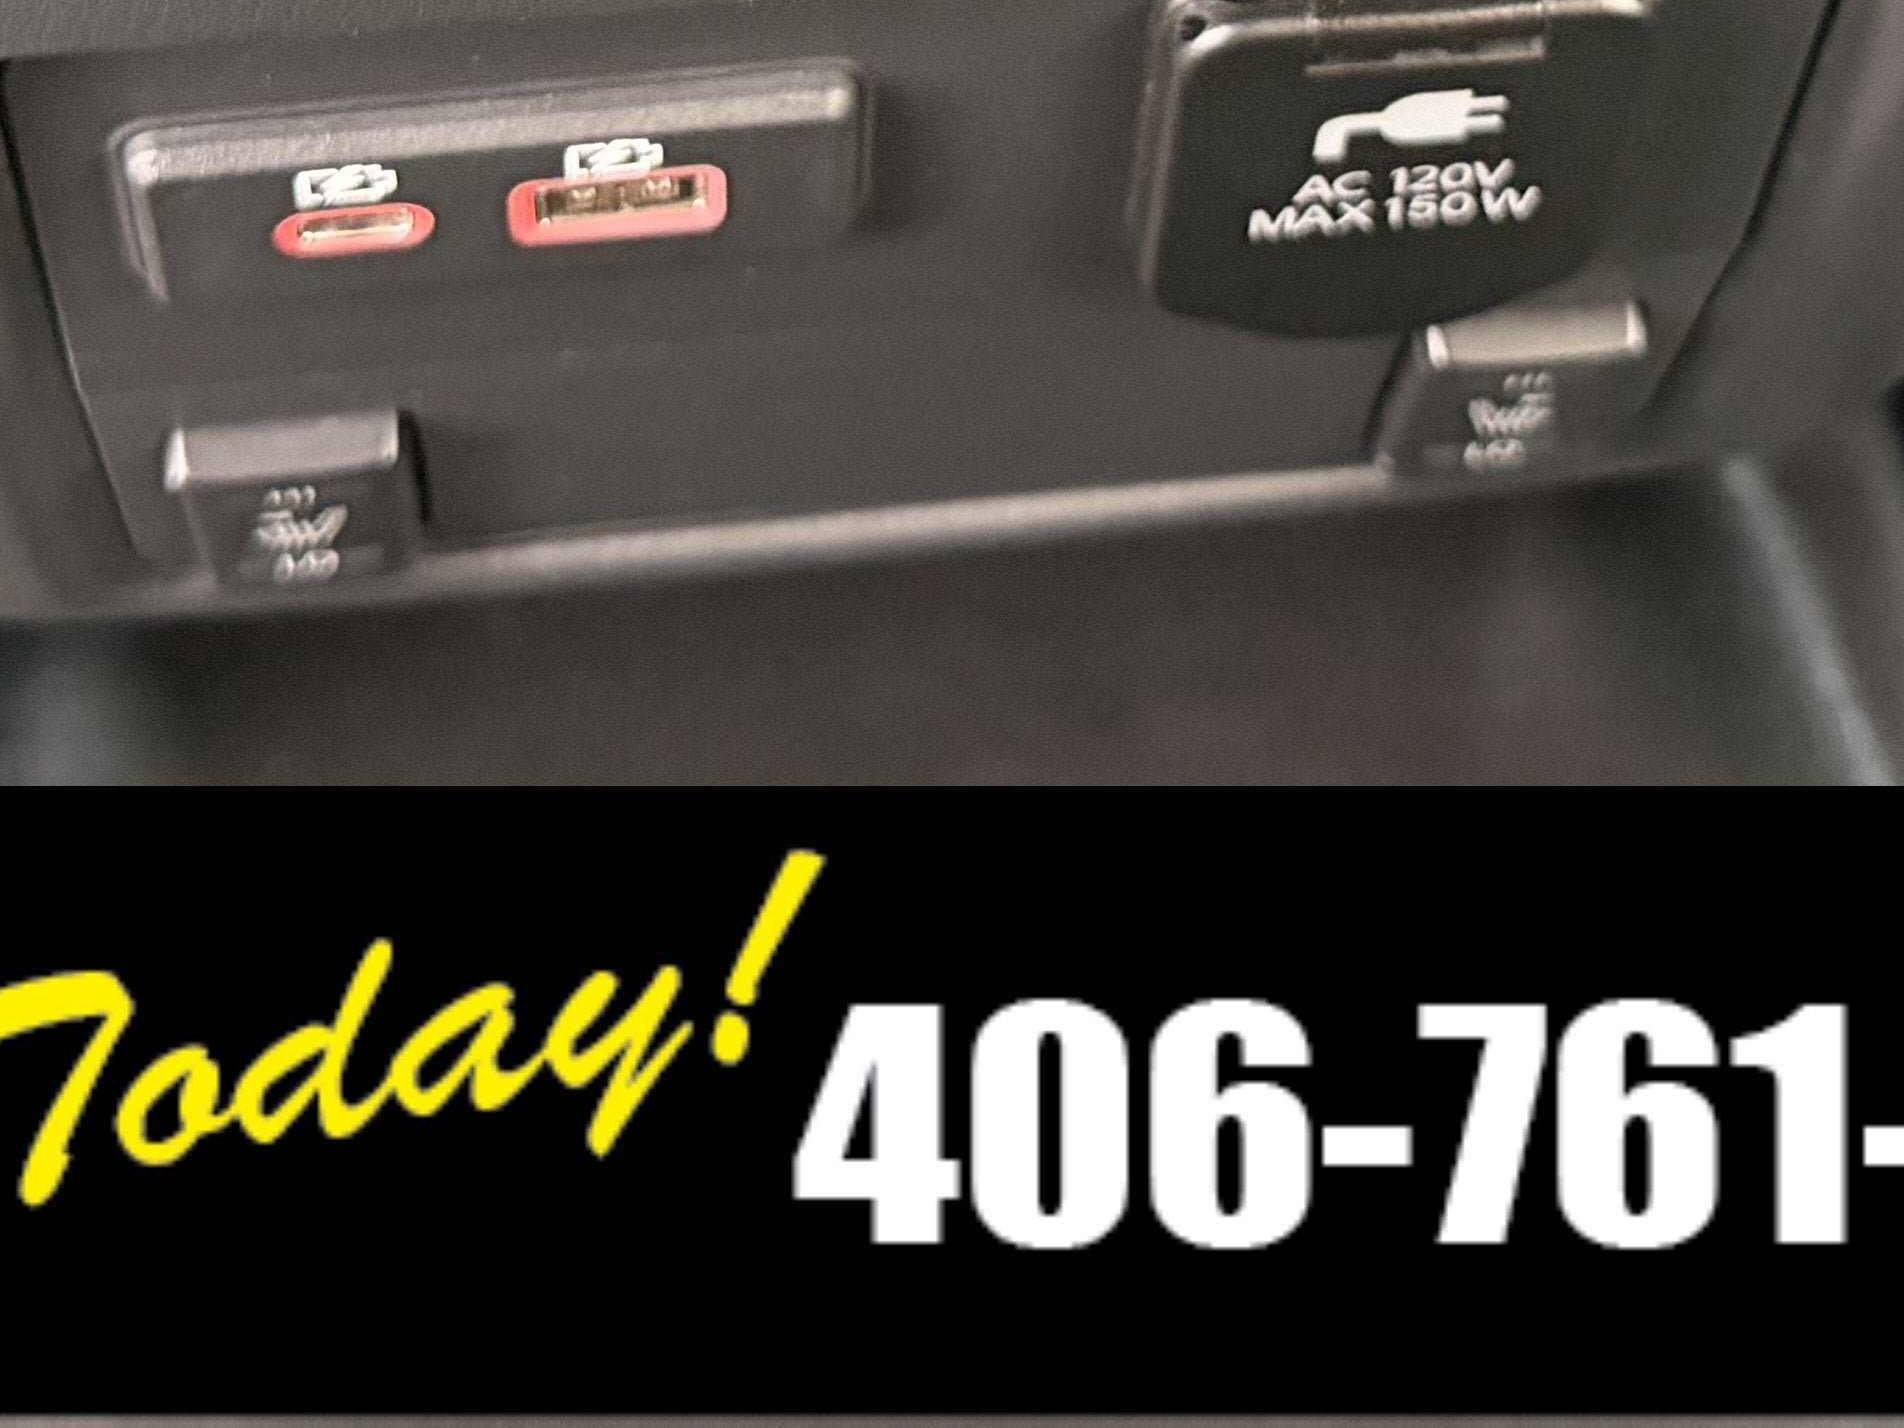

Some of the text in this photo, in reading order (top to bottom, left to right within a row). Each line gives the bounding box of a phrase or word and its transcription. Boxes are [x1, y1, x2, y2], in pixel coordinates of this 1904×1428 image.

[1293, 158, 1515, 207] AC 120V
[1248, 185, 1542, 243] MAX 150W
